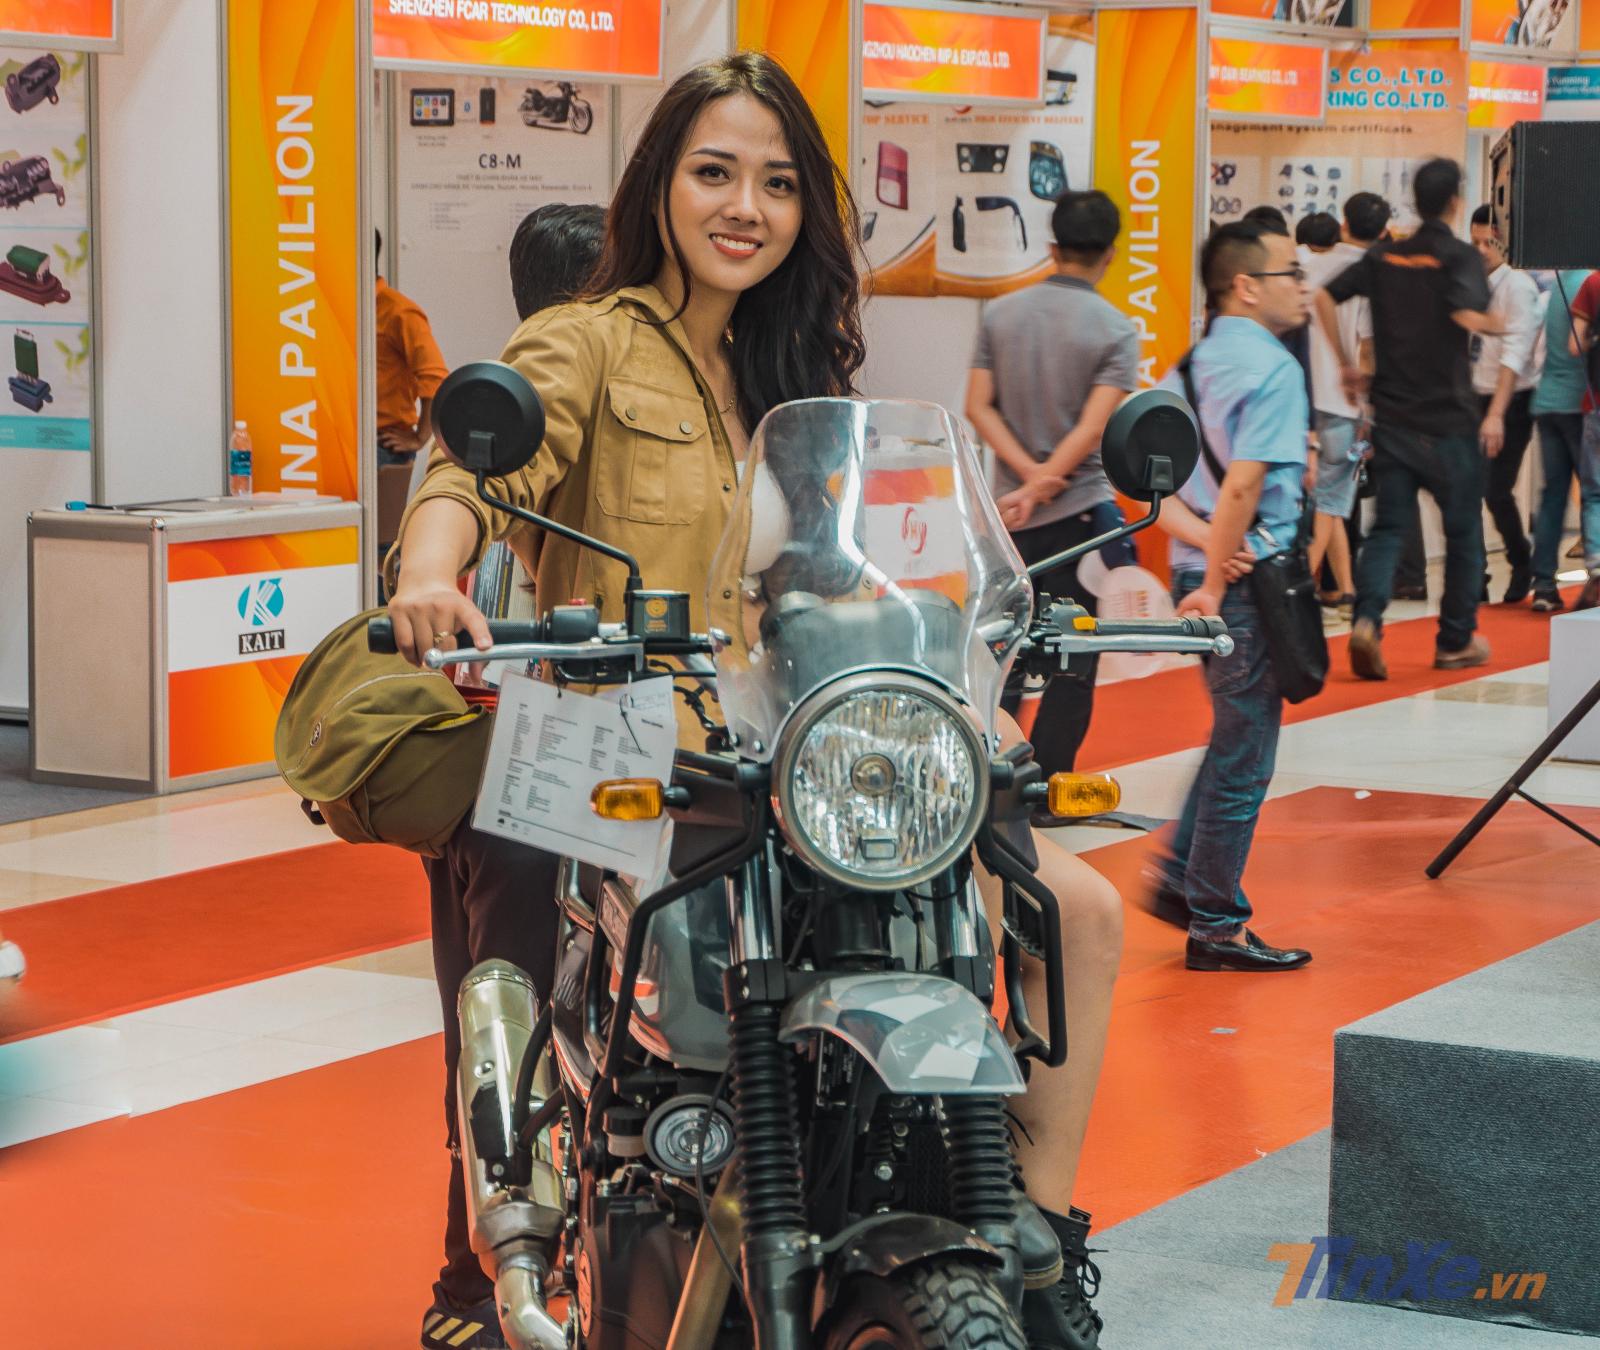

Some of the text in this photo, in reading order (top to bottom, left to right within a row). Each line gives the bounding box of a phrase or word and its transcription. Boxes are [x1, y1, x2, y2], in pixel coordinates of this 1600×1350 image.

[389, 0, 454, 18] SHENZHEN
[457, 0, 489, 23] FCAR
[490, 2, 567, 27] TECHNOLOGY
[591, 11, 615, 31] LTD.
[479, 153, 521, 169] C8-M
[1128, 140, 1160, 341] PAVILION
[276, 94, 318, 496] INA PAVILION
[240, 630, 284, 653] KAIT
